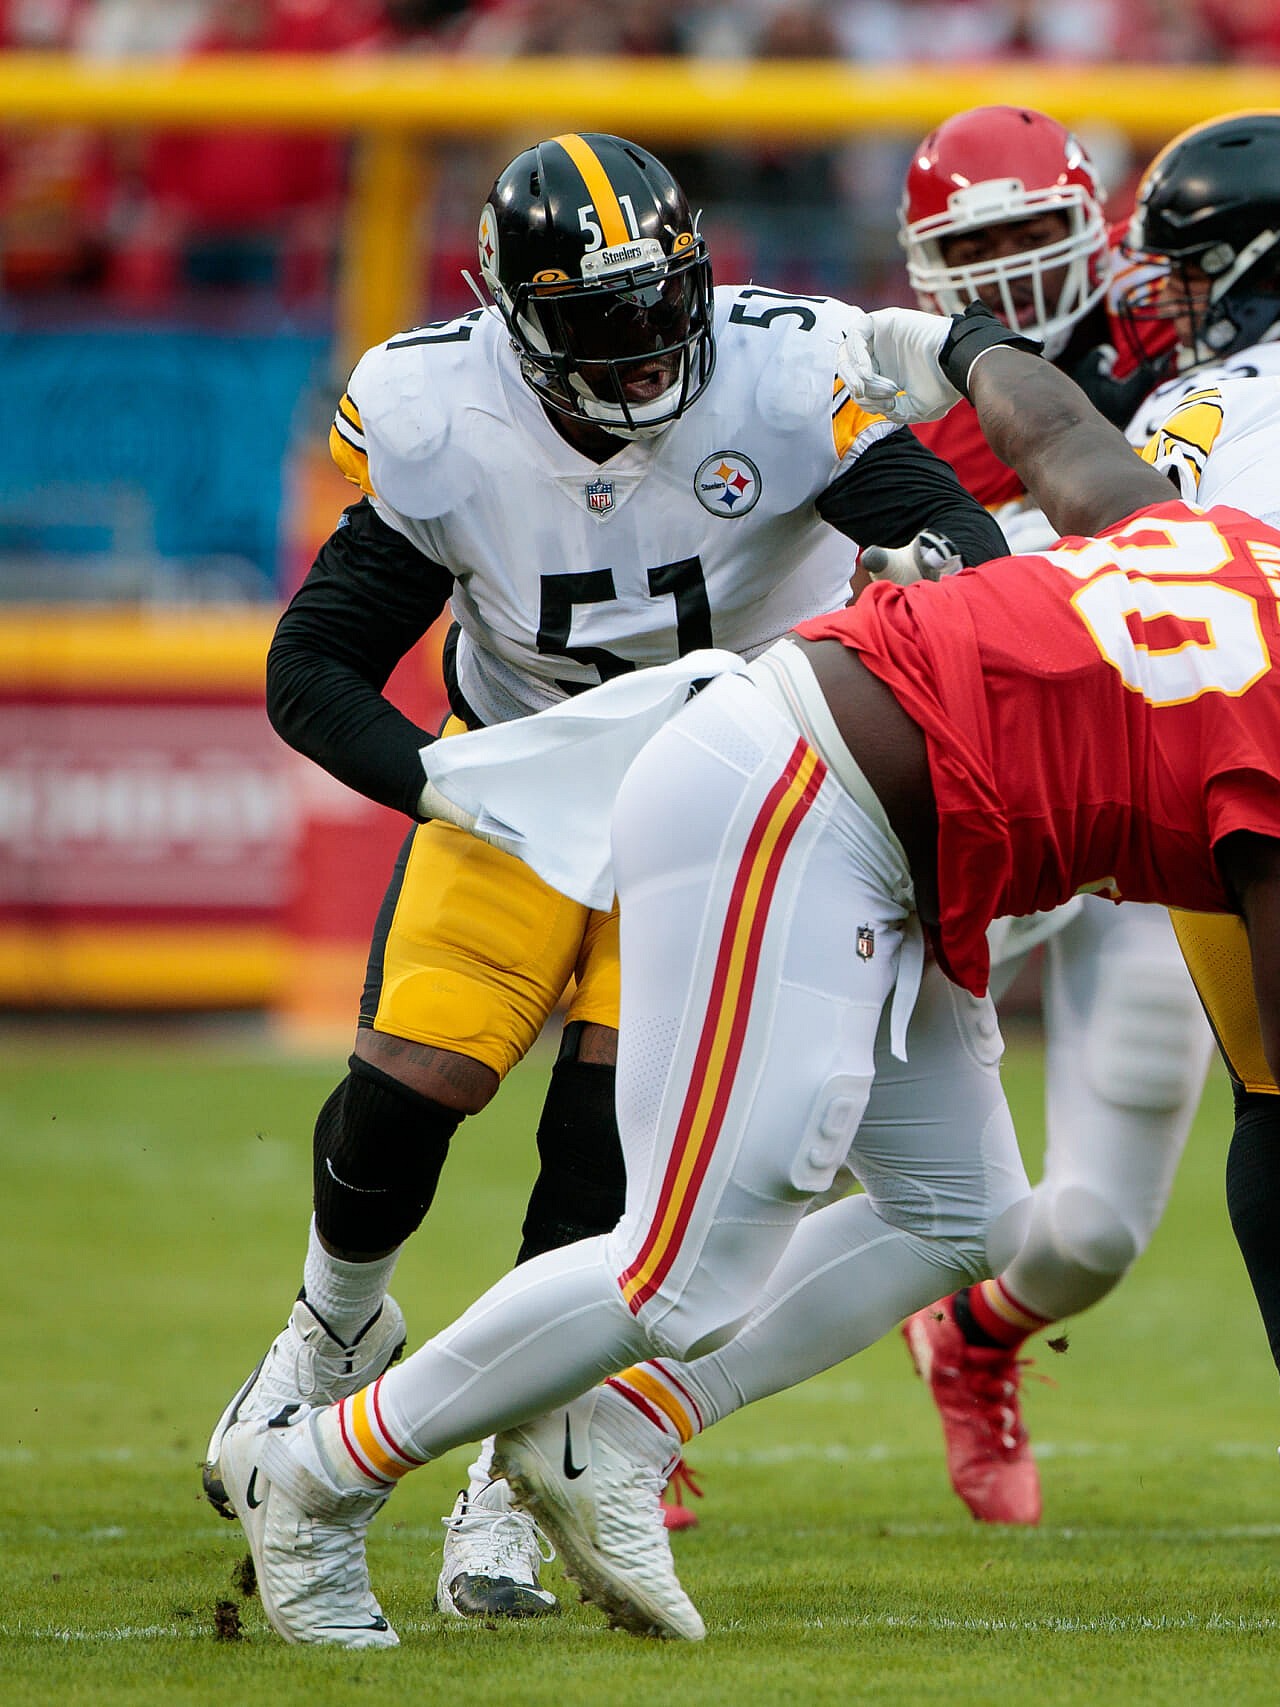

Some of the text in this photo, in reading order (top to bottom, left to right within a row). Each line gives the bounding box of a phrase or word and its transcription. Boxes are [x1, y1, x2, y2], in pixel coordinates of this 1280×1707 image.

[577, 194, 641, 253] 51
[602, 247, 642, 264] Steelers
[728, 289, 828, 332] 51
[536, 555, 714, 698] 51
